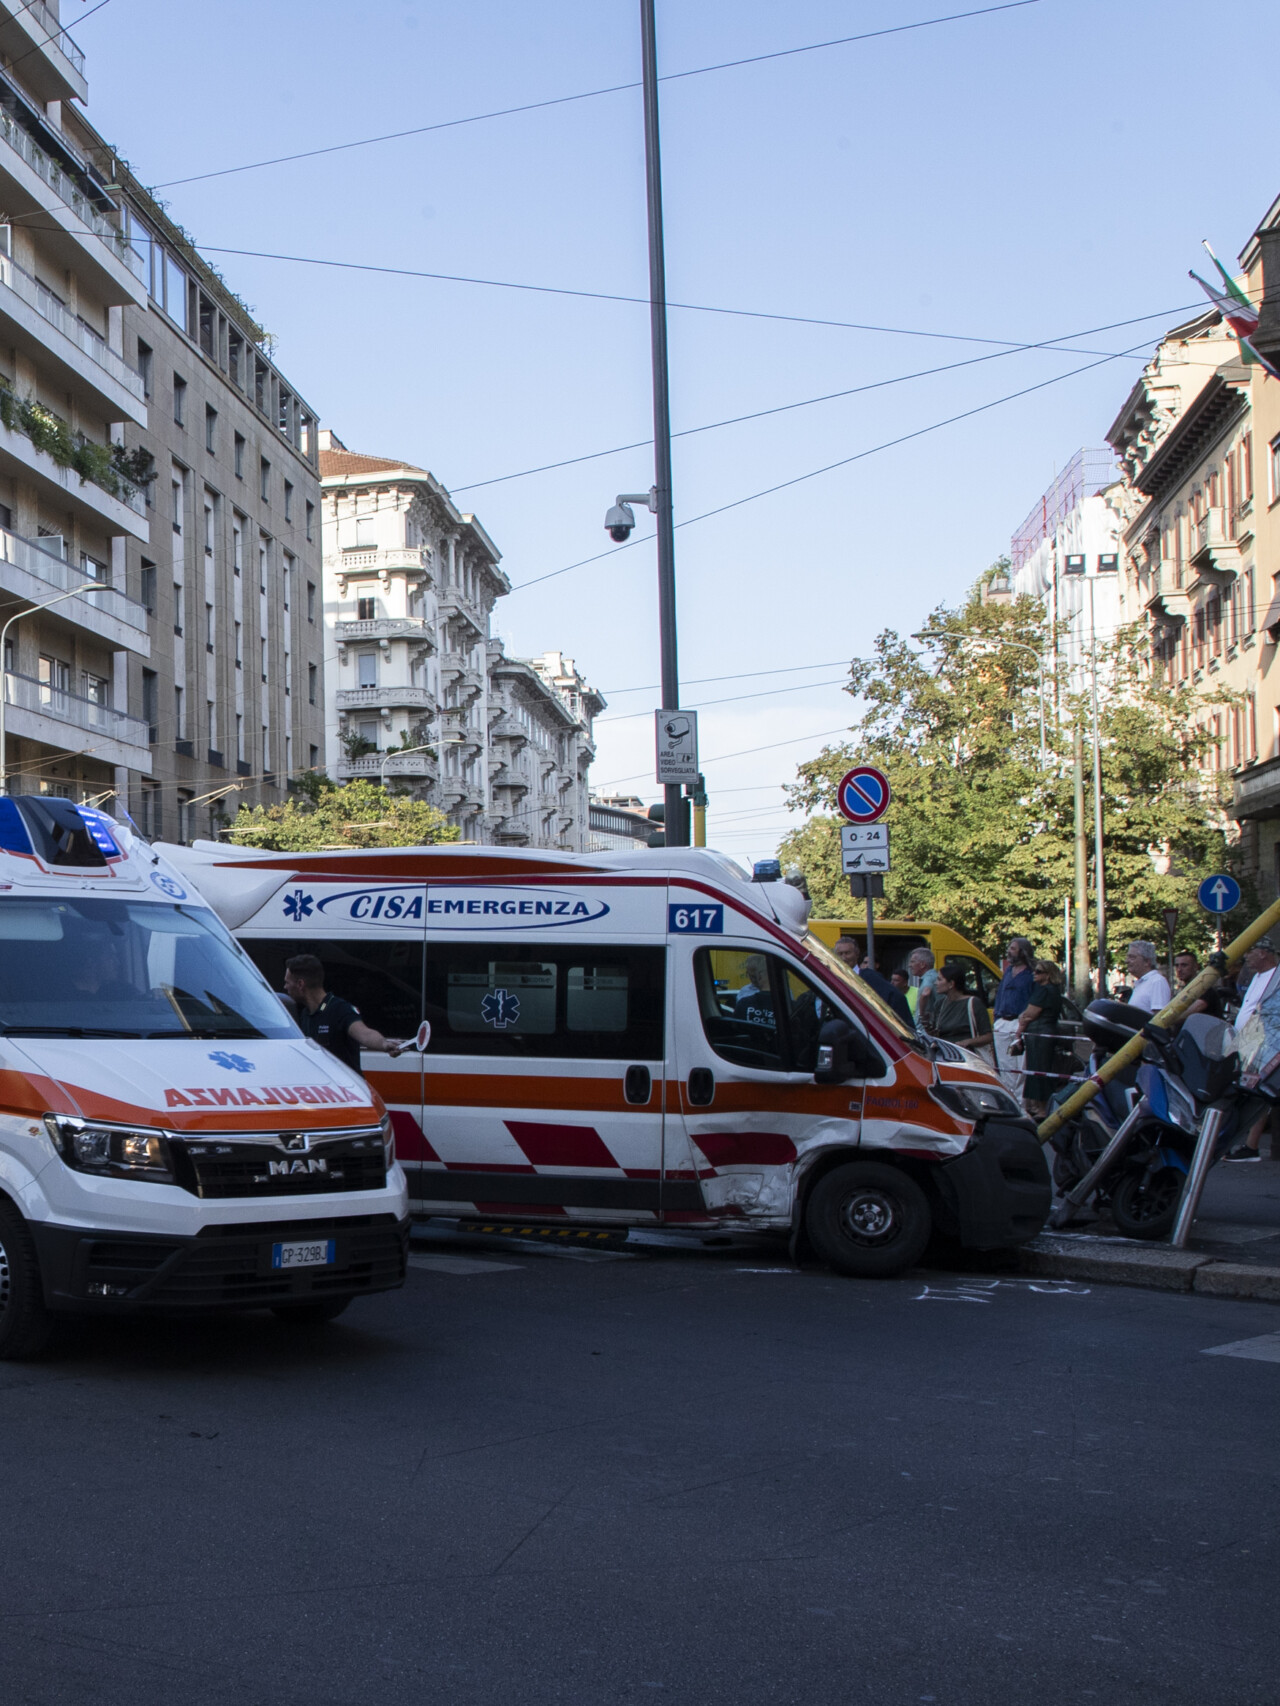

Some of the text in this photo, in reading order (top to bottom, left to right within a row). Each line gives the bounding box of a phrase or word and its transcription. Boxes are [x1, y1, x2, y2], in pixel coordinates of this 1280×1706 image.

[866, 831, 881, 841] 24
[350, 895, 590, 919] CISA EMERGENZA
[674, 909, 717, 929] 617
[267, 1158, 328, 1176] MAN
